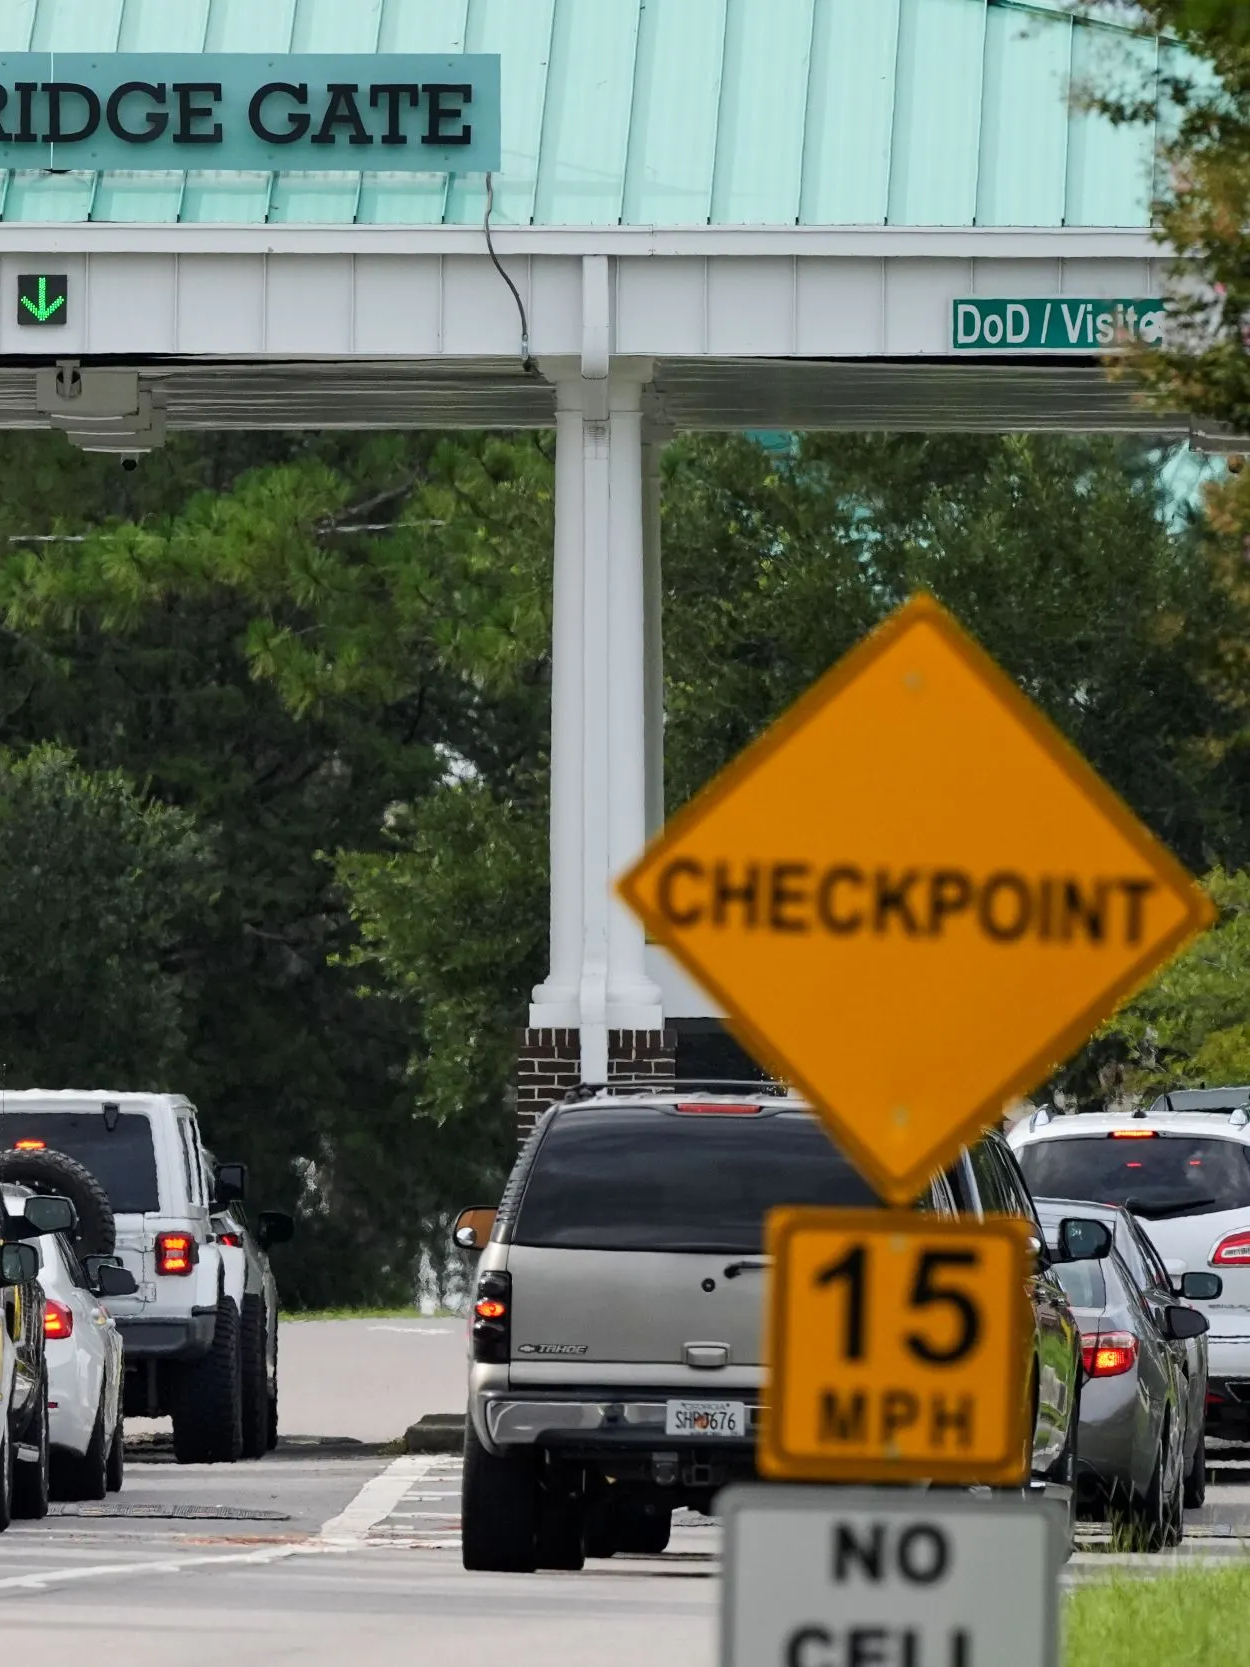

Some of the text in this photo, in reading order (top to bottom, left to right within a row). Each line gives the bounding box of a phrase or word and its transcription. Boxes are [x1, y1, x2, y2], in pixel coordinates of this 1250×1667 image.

[248, 82, 472, 145] GATE
[957, 303, 1174, 344] DoD / Visito
[656, 857, 1160, 949] CHECKPOINT
[814, 1242, 984, 1367] 15
[538, 1344, 588, 1354] TAHOE
[819, 1388, 974, 1446] MPH
[830, 1521, 952, 1586] NO
